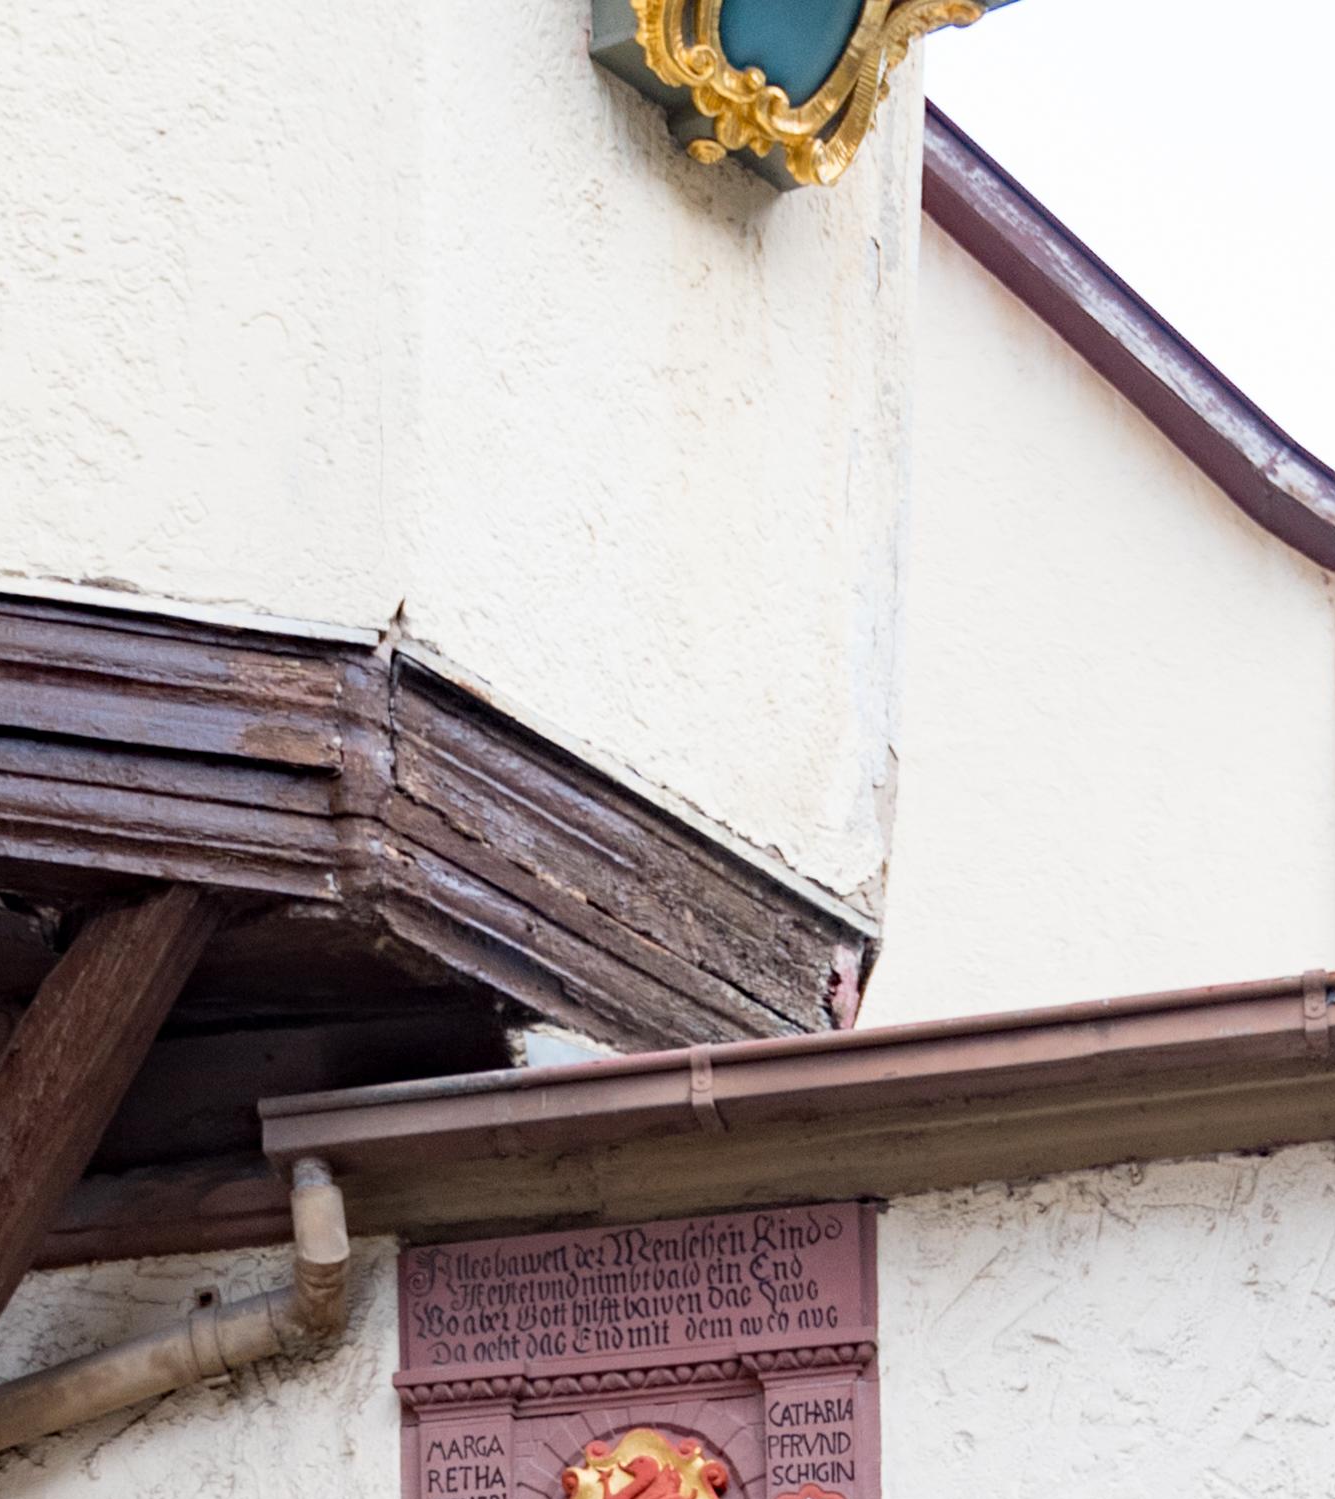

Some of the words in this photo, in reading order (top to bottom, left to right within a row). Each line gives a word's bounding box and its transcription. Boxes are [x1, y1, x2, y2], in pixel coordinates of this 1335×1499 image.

[426, 1434, 505, 1462] MARGA
[767, 1432, 852, 1460] PFRVND
[428, 1465, 507, 1493] RETHA
[772, 1460, 855, 1486] SCHIGIN
